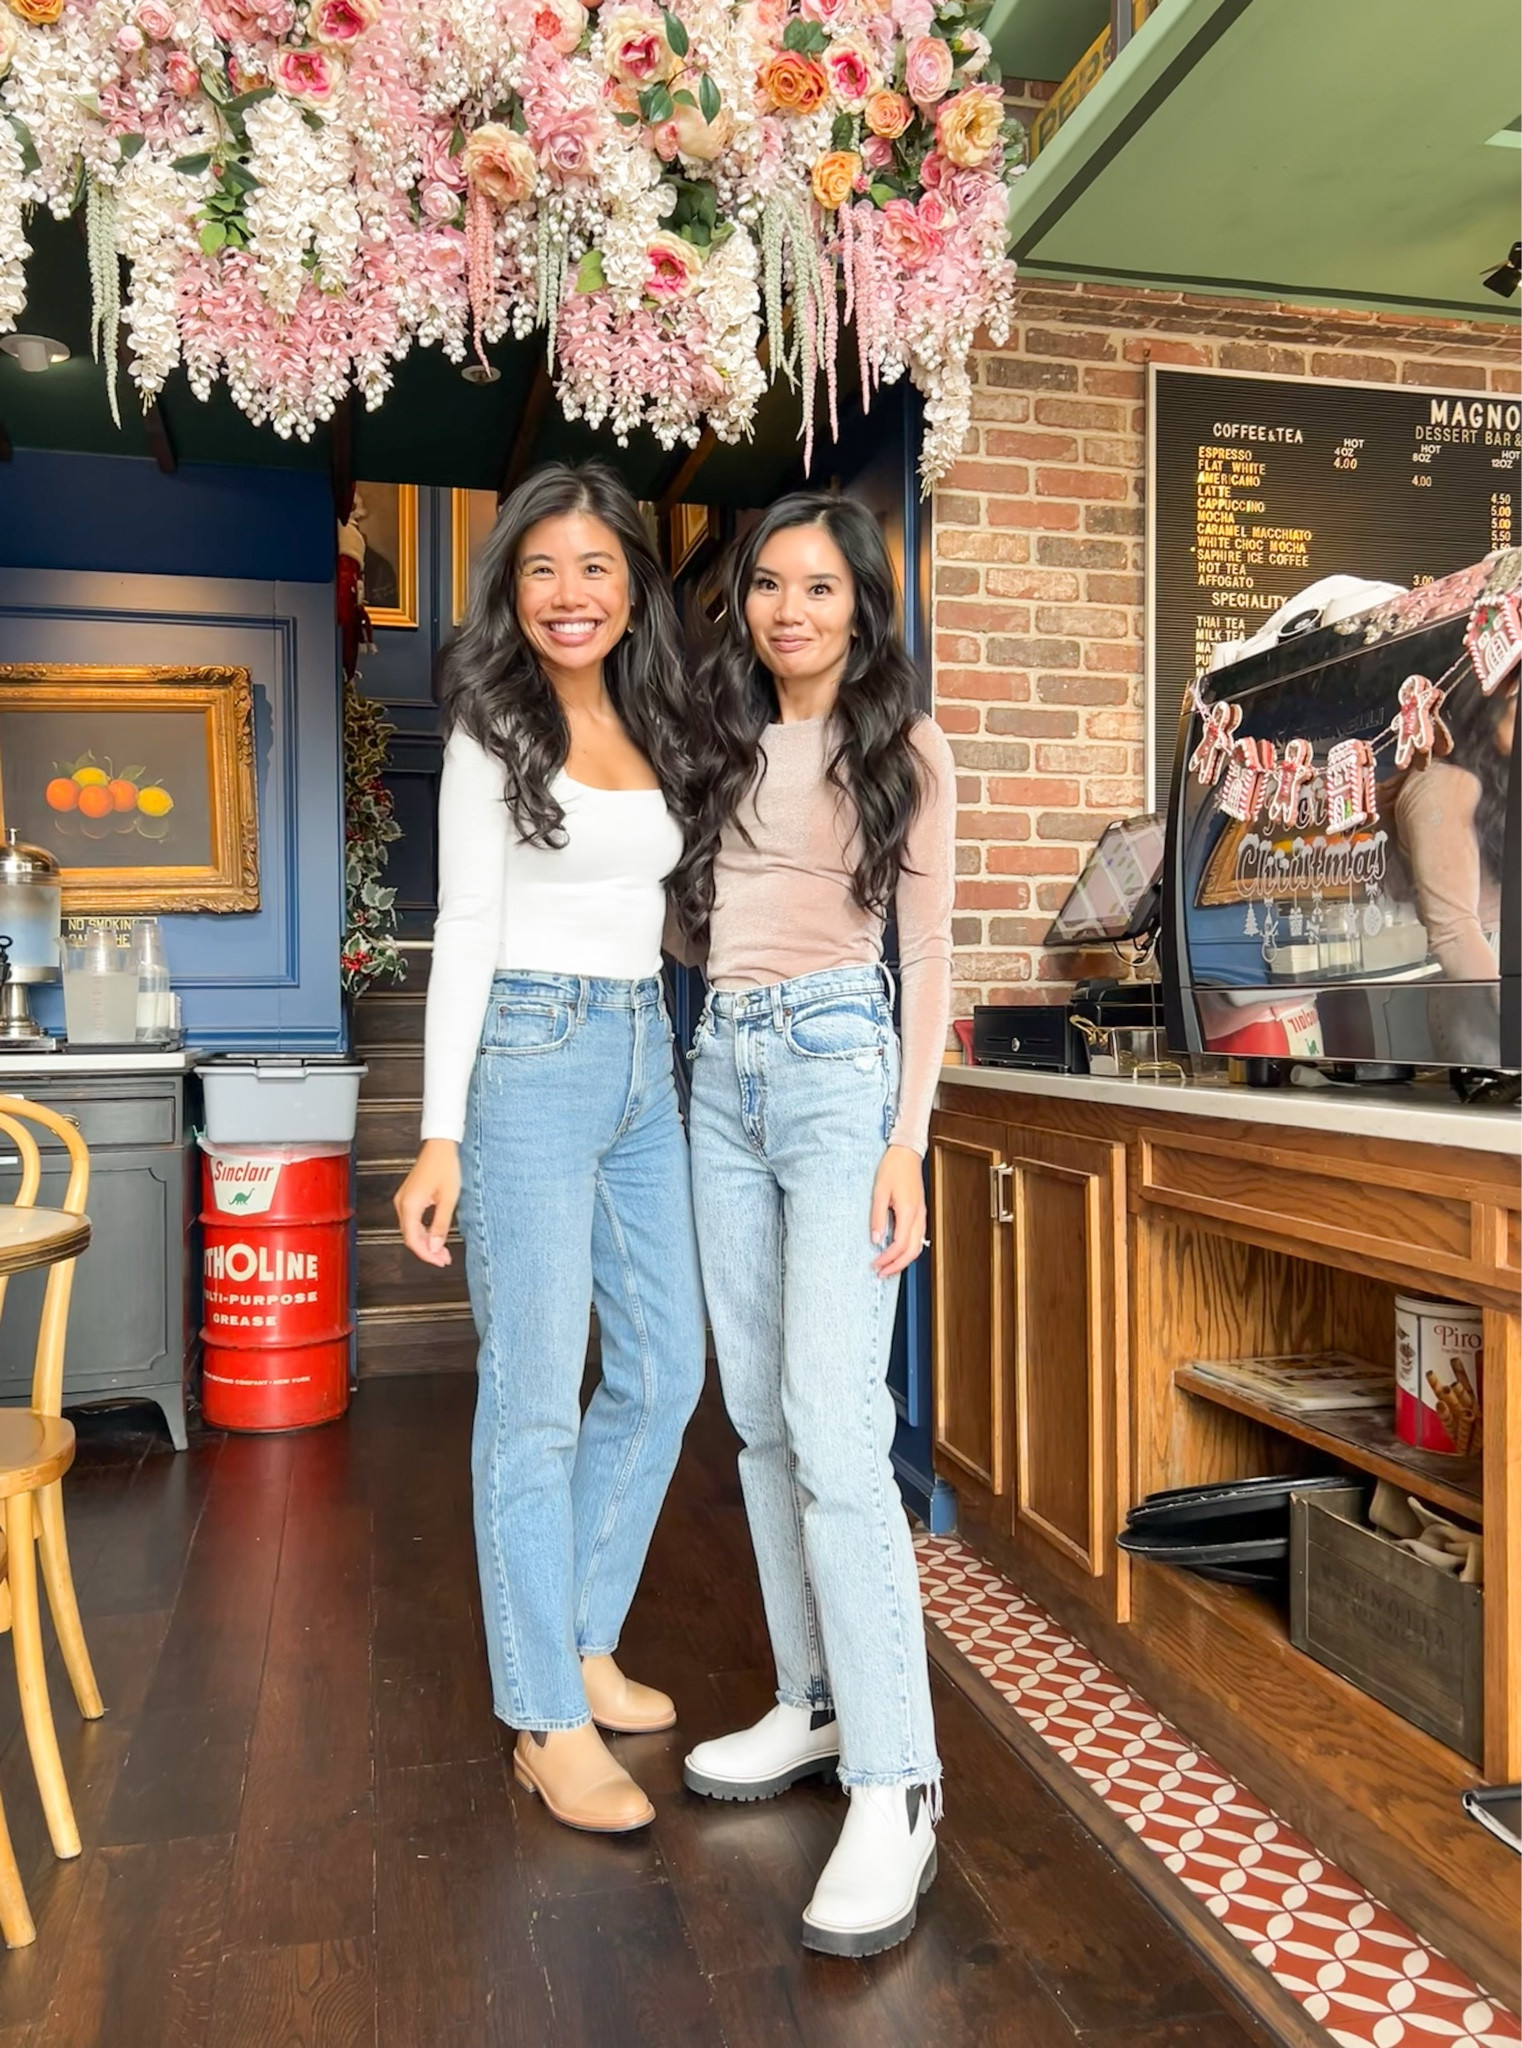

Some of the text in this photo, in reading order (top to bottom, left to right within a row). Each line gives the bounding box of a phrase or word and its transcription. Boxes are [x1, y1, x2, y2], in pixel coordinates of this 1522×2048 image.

[1431, 398, 1521, 431] MAGNO
[1212, 422, 1304, 444] COFFEE&TEA
[1415, 425, 1478, 444] DESSERT
[1343, 438, 1365, 449] HOT
[1420, 444, 1442, 454] HOT
[1198, 446, 1253, 461] ESPRESSO
[1501, 450, 1521, 460] HOT
[1197, 459, 1267, 475] FLAT WHITE
[1333, 456, 1358, 470] 4.00
[1196, 471, 1261, 487] AMERICANO
[1411, 474, 1433, 487] 4.00
[1197, 485, 1232, 498] LATTE
[1490, 493, 1511, 505] 4.50
[1197, 498, 1266, 513] CAPPUCCINO
[1490, 505, 1512, 517] 5.00
[1196, 510, 1236, 524] MOCHA
[1490, 517, 1512, 529] 5.00
[1196, 523, 1313, 541] CARAMEL MACCHIATO
[1491, 530, 1511, 542] 5.50
[1196, 535, 1307, 554] WHITE CHOC MOCHA
[1196, 548, 1310, 568] SAPHIRE ICE COFFEE
[1197, 561, 1247, 576] HOT TEA
[1197, 574, 1254, 588] AFFOGATO
[1195, 615, 1246, 630] THAI TEA
[1195, 628, 1246, 642] MILK TEA
[1235, 829, 1389, 898] Christmas
[68, 919, 84, 931] NO
[214, 1160, 275, 1182] Sinclair
[212, 1312, 278, 1328] GREASE
